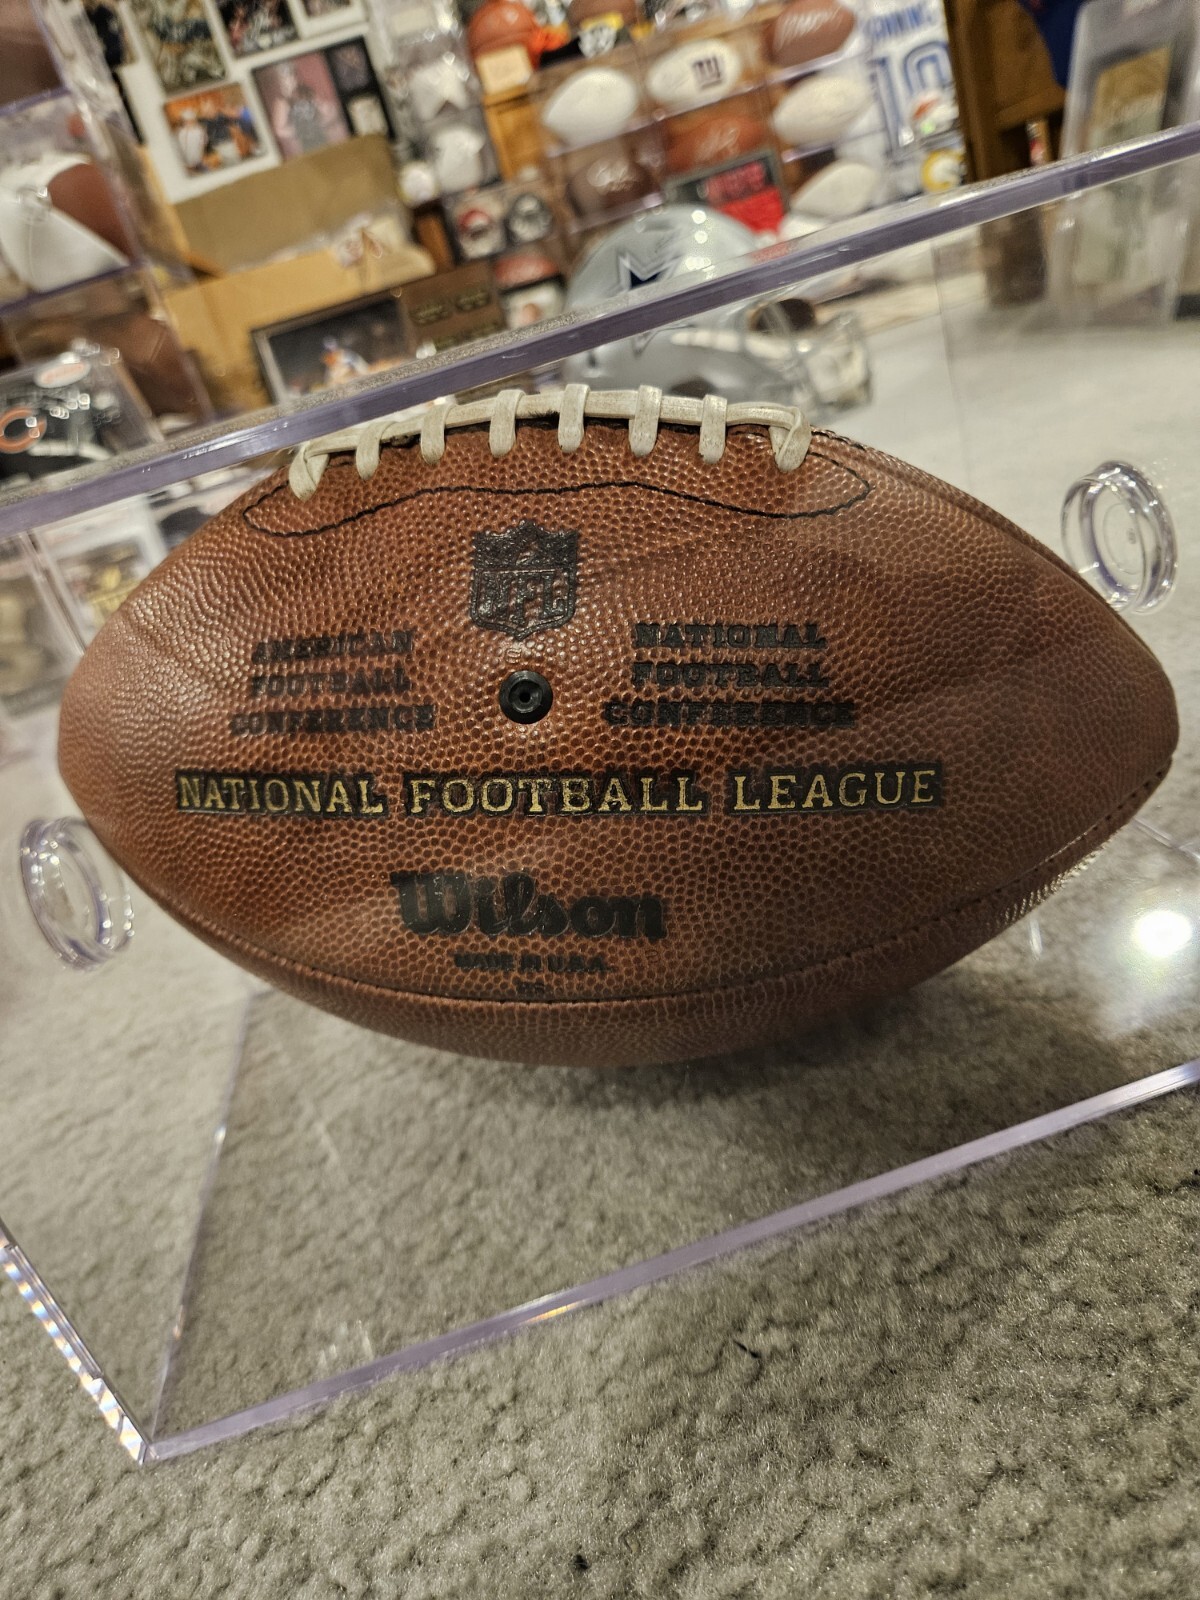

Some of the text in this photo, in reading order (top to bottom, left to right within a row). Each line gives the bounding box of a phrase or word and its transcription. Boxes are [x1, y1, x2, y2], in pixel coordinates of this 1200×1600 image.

[252, 629, 416, 664] AMERICAN
[633, 621, 827, 650] NATIONAL
[252, 664, 412, 697] FOOTBALL
[632, 661, 829, 688] FOOTBALL
[230, 704, 436, 736] CONFERENCE
[602, 700, 856, 728] CONFERENCE
[177, 768, 937, 815] NATIONAL FOOTBALL LEAGUE
[390, 870, 666, 938] Wilson
